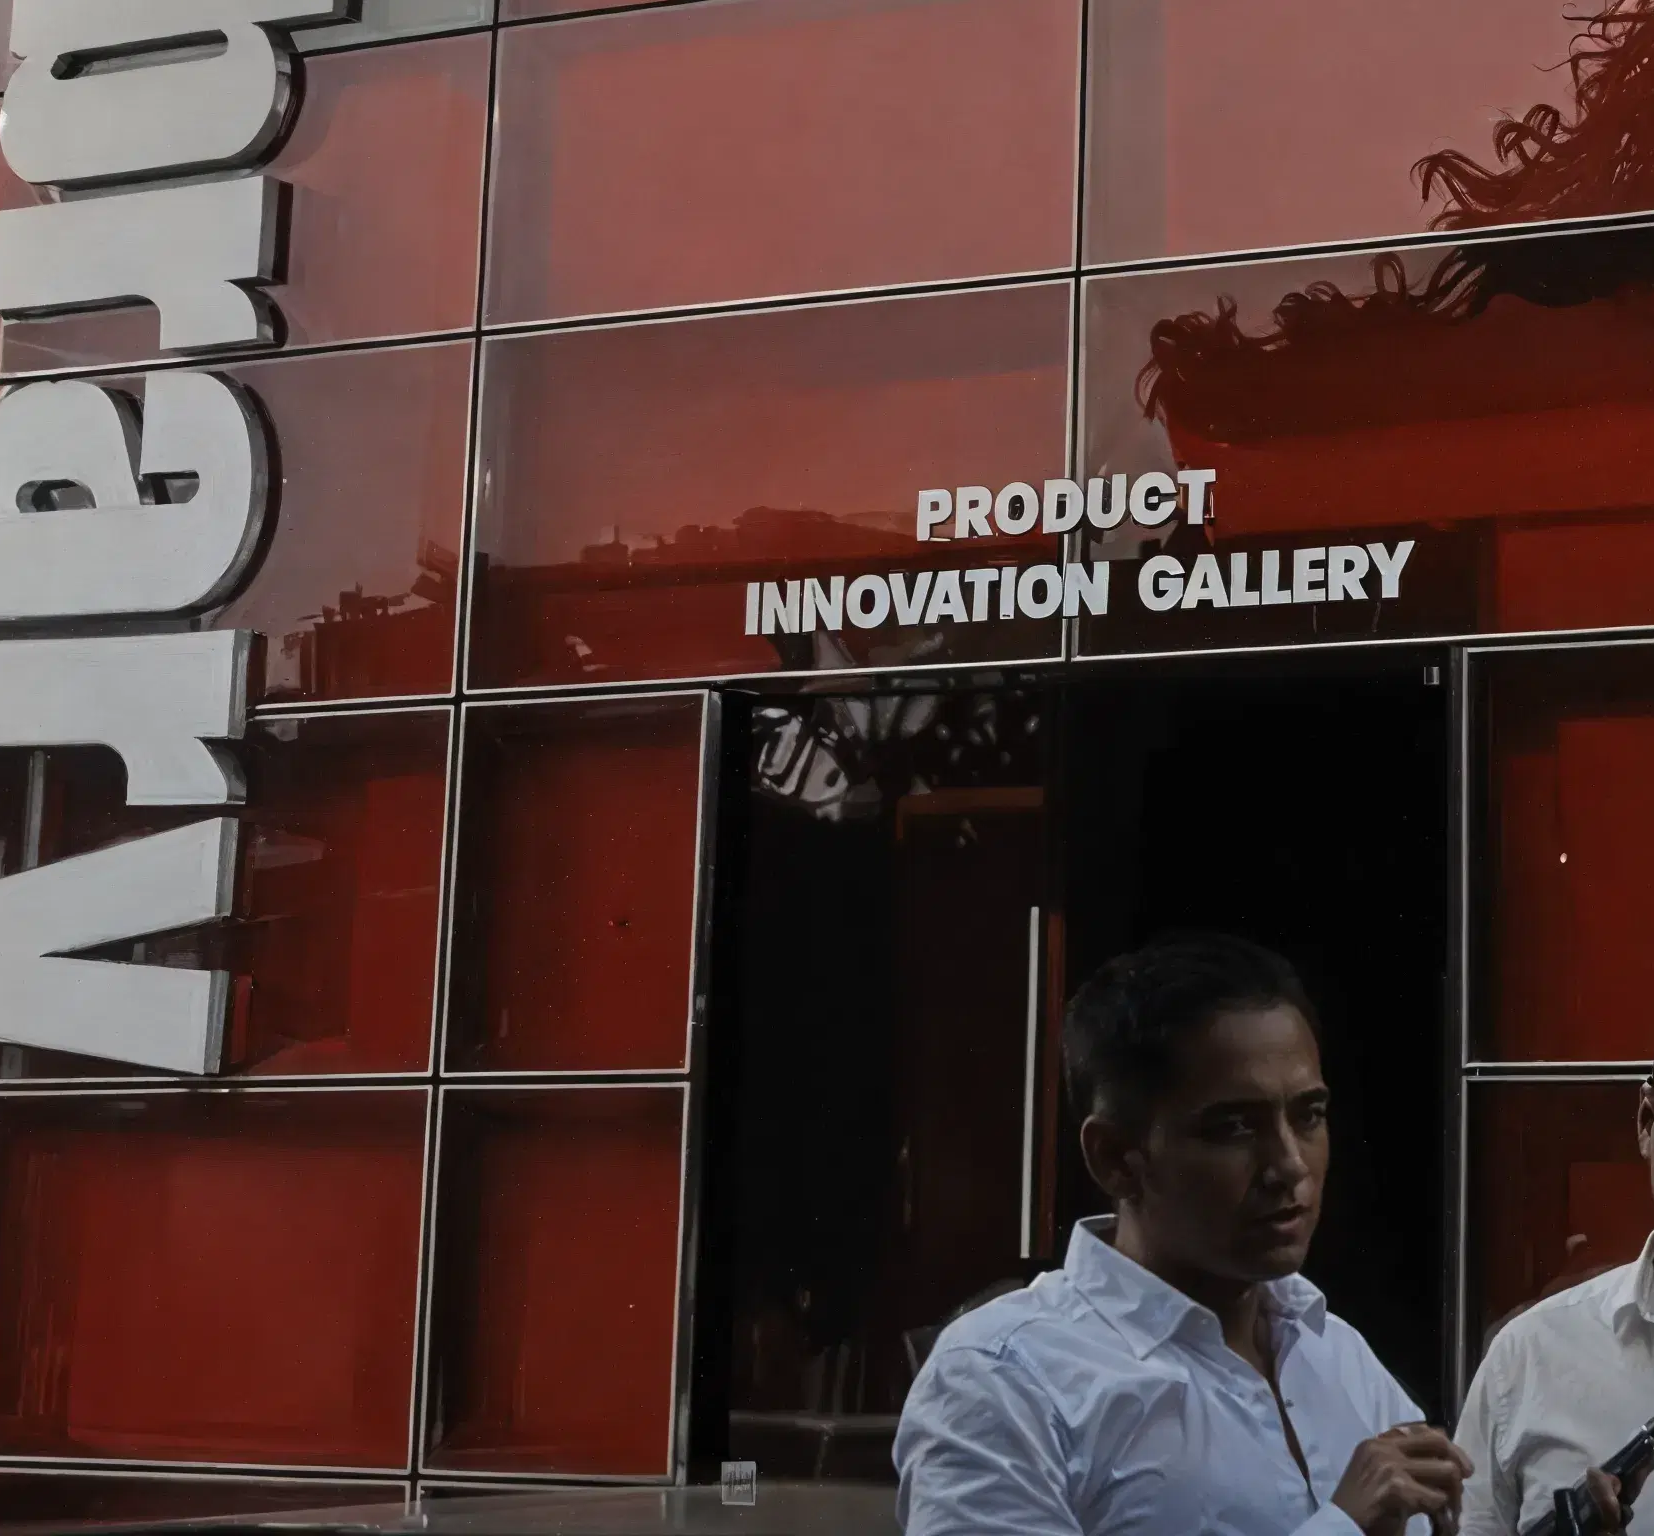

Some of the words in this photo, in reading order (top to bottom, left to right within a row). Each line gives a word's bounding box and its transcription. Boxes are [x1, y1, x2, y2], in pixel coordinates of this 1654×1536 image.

[916, 468, 1217, 542] PRODUCT
[744, 561, 1110, 636] INNOVATION
[1137, 540, 1416, 612] GALLERY
